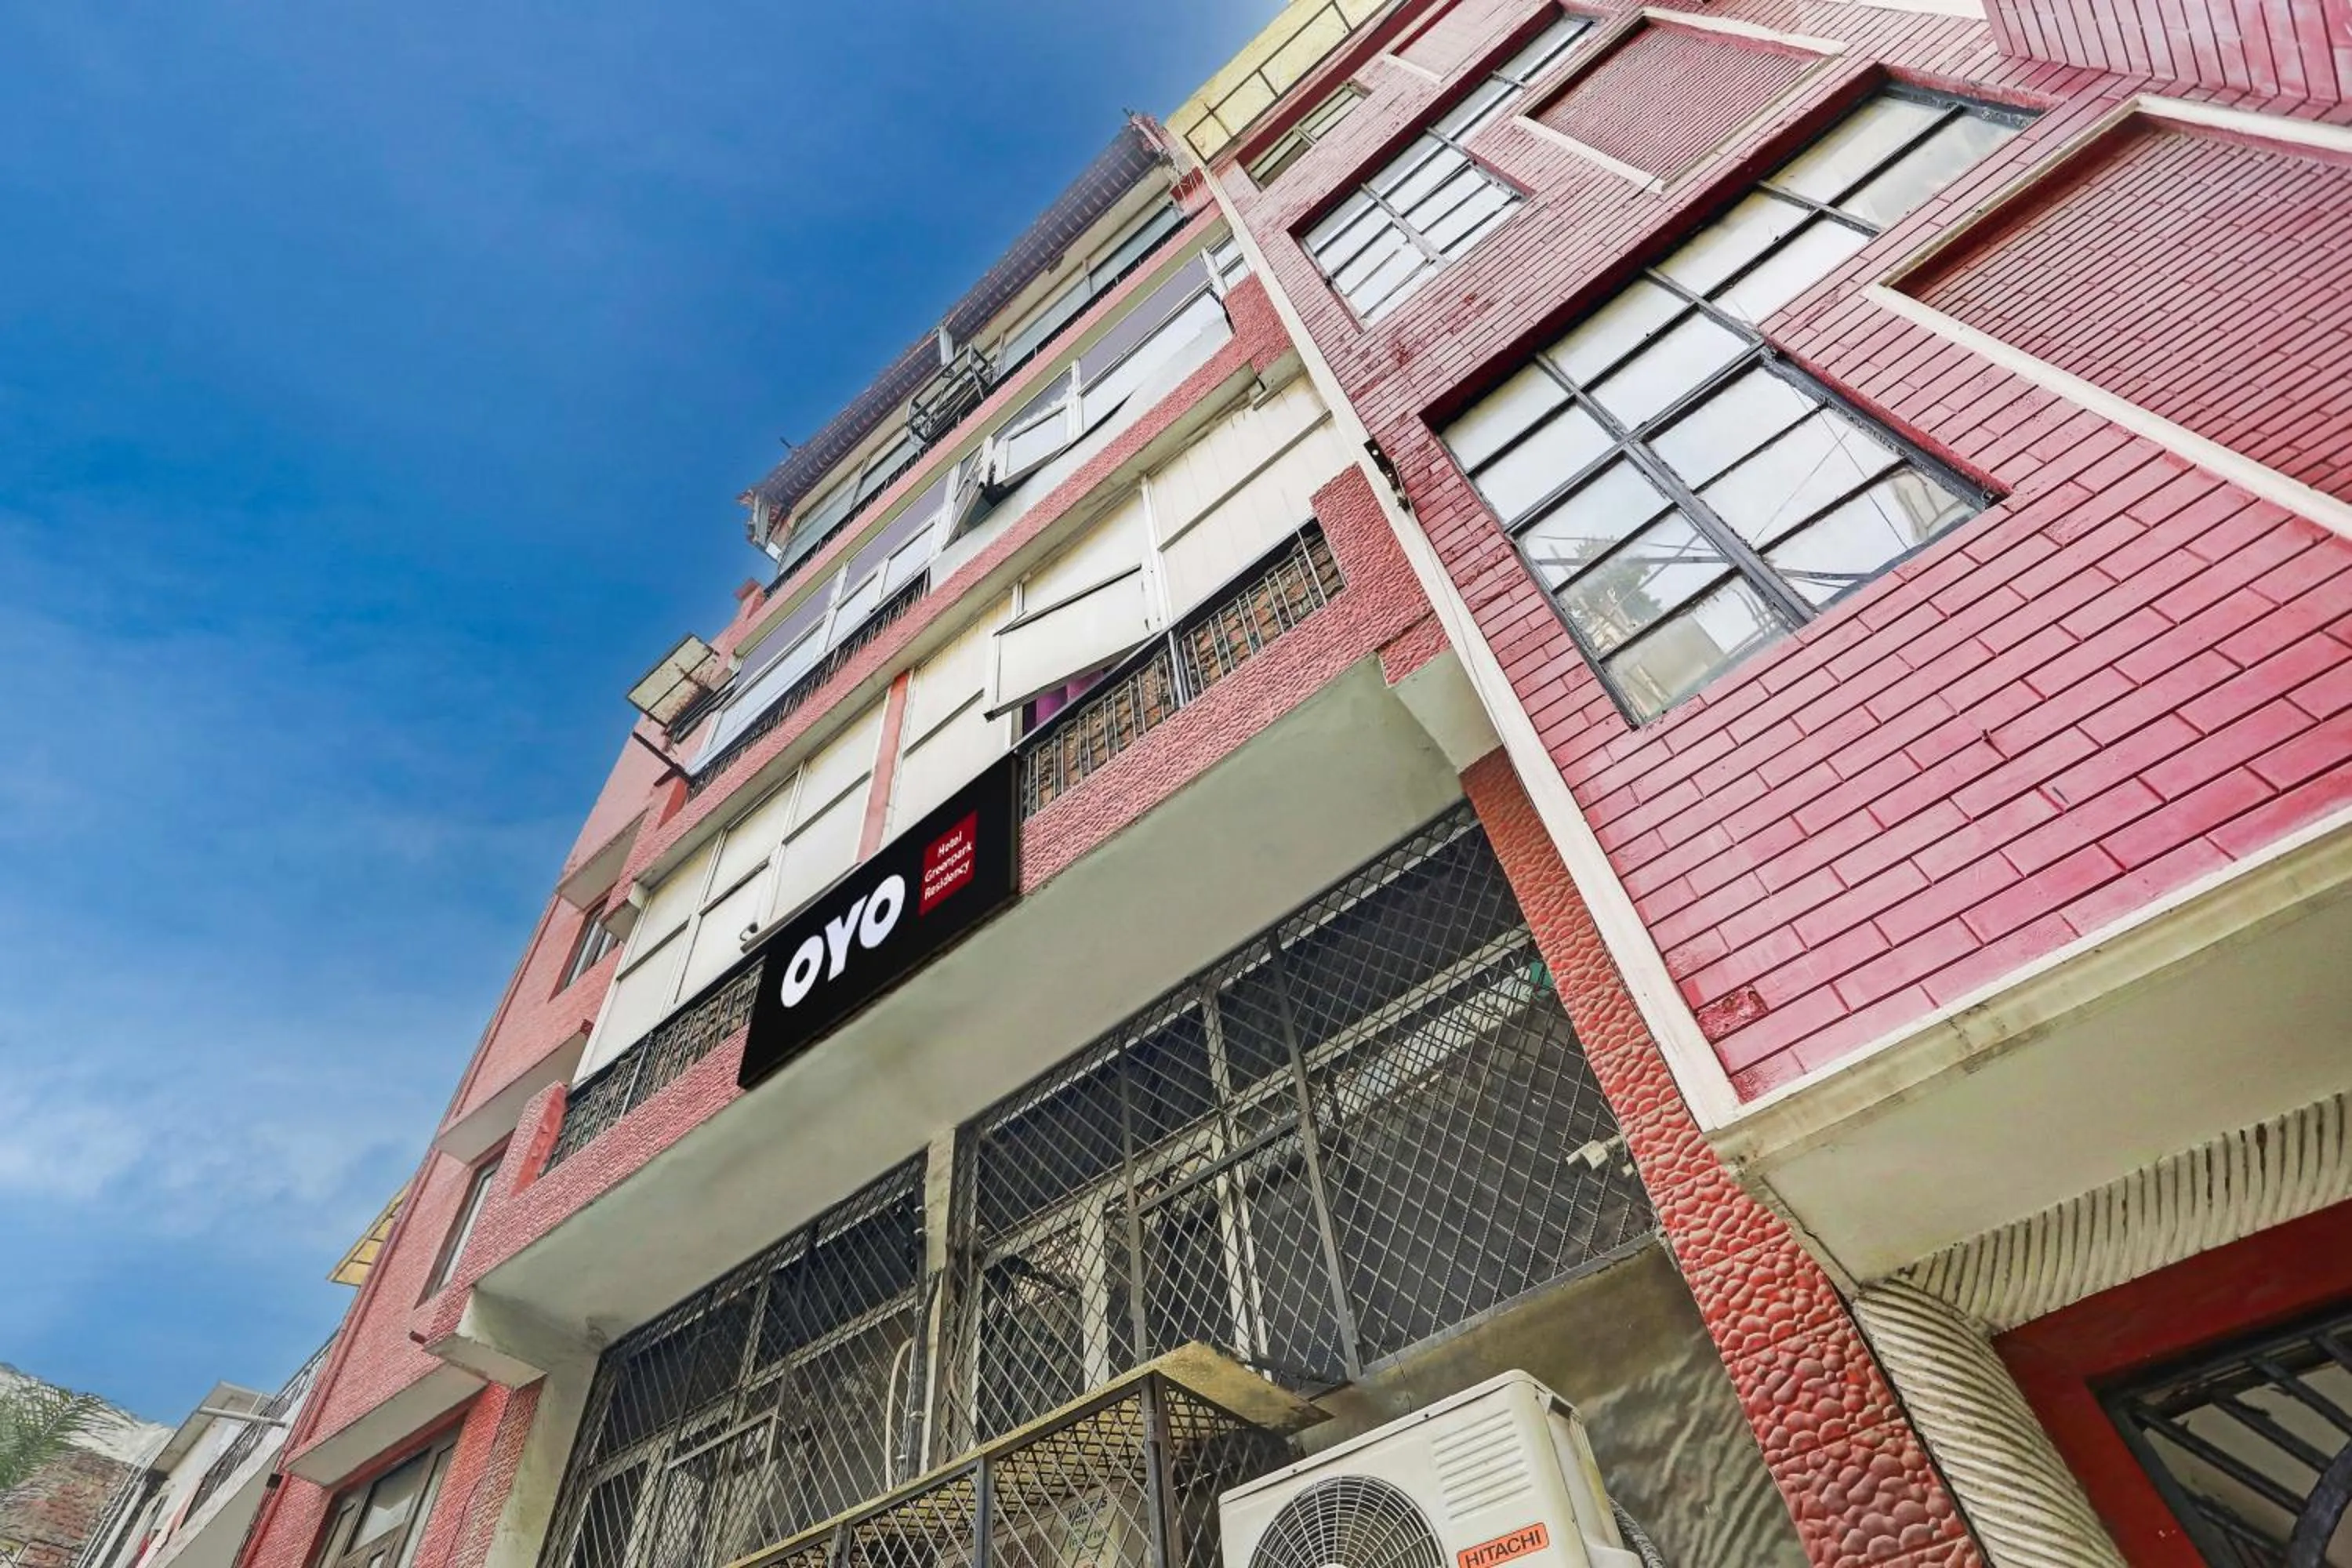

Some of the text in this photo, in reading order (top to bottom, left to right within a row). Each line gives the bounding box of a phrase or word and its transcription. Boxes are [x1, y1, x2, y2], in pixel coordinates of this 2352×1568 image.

[924, 841, 973, 883] Greenpark
[937, 830, 963, 858] Hotel
[924, 860, 971, 901] Residency
[781, 874, 906, 1007] OYO
[1465, 1530, 1542, 1568] HITACHI
